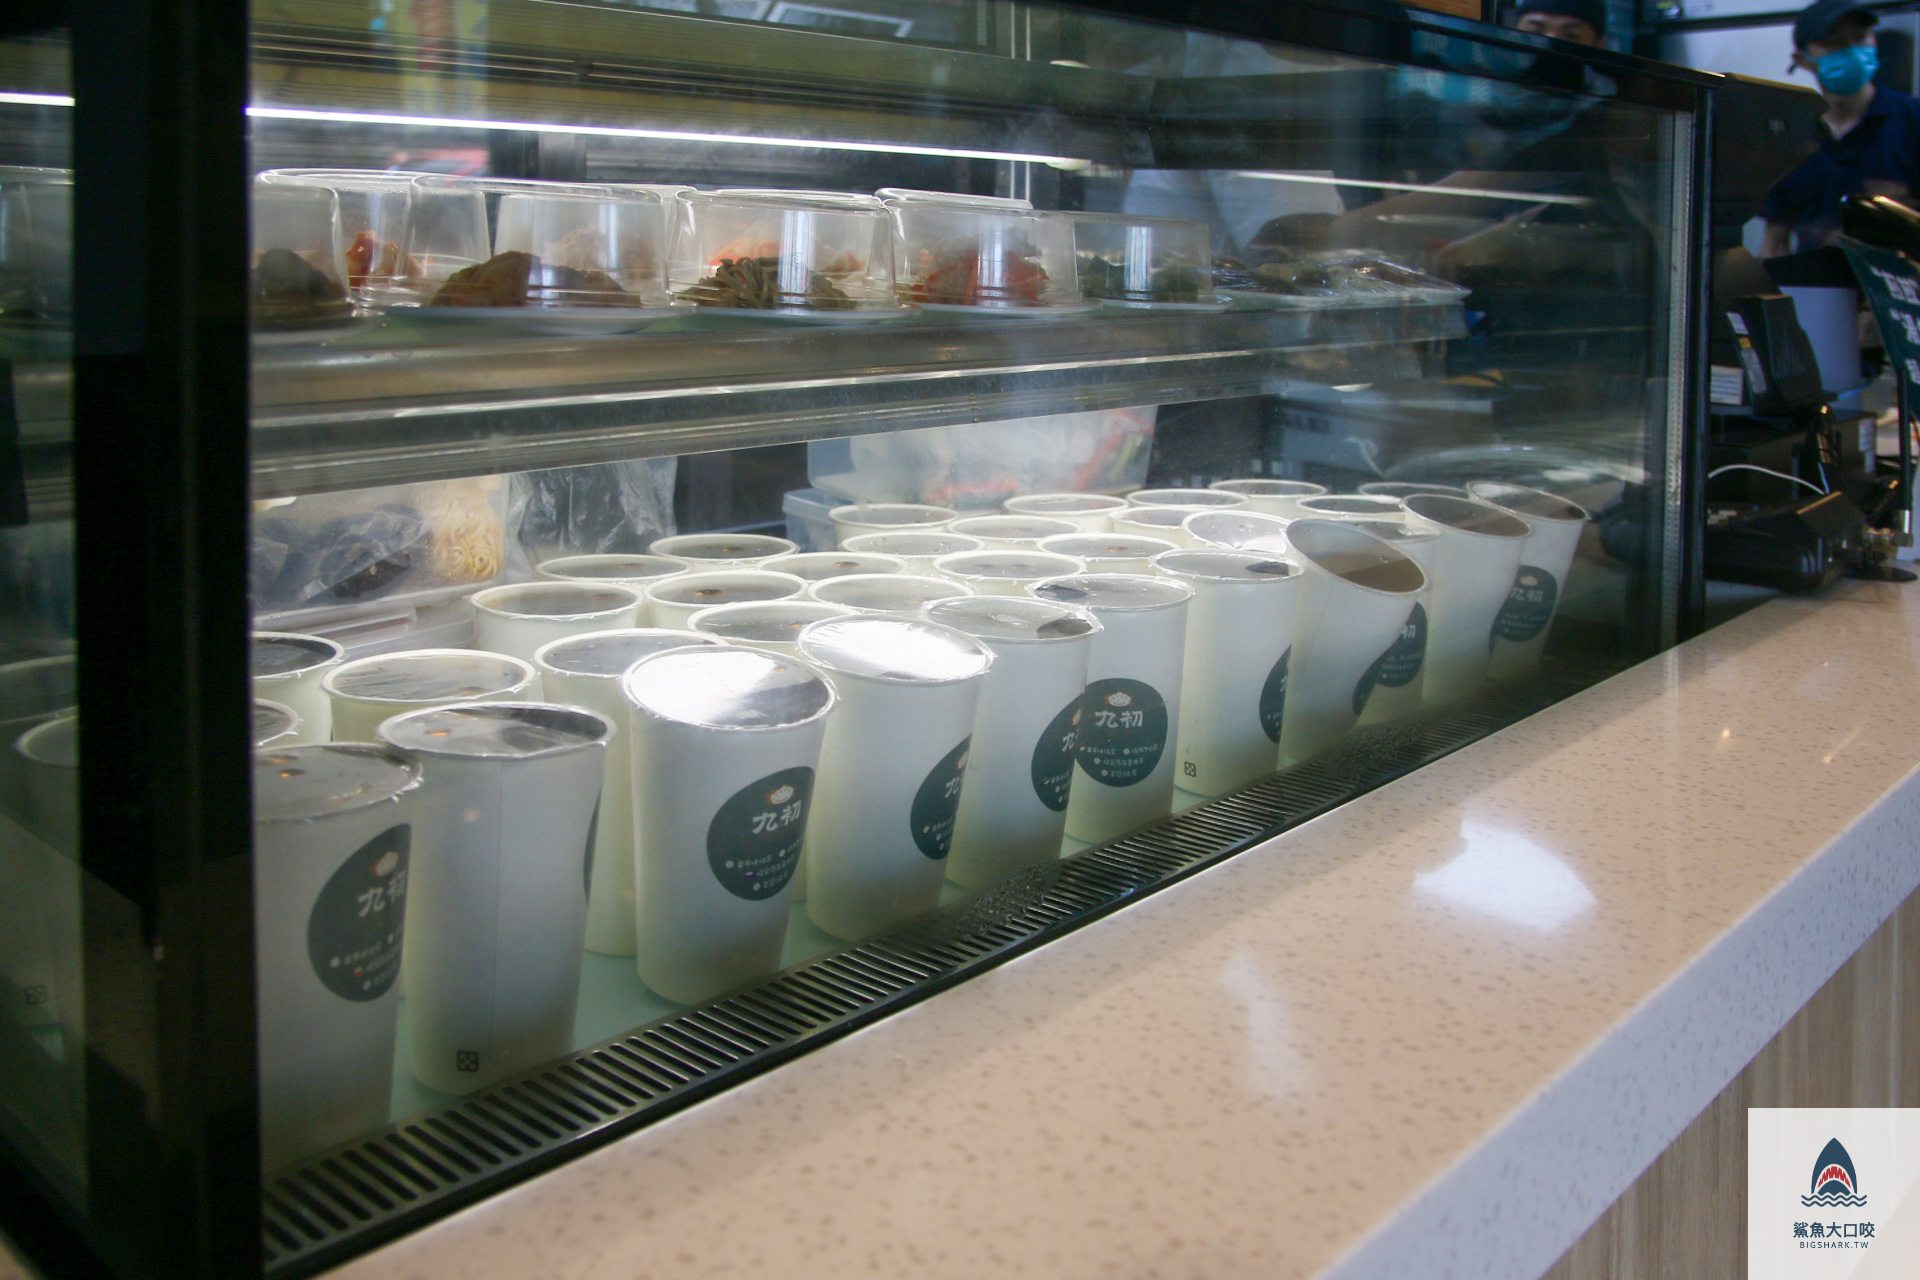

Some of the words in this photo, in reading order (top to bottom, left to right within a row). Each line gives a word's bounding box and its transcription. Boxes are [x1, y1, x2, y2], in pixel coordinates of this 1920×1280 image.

[1094, 710, 1144, 728] 九初
[1062, 730, 1080, 752] 九
[752, 799, 802, 834] 九初
